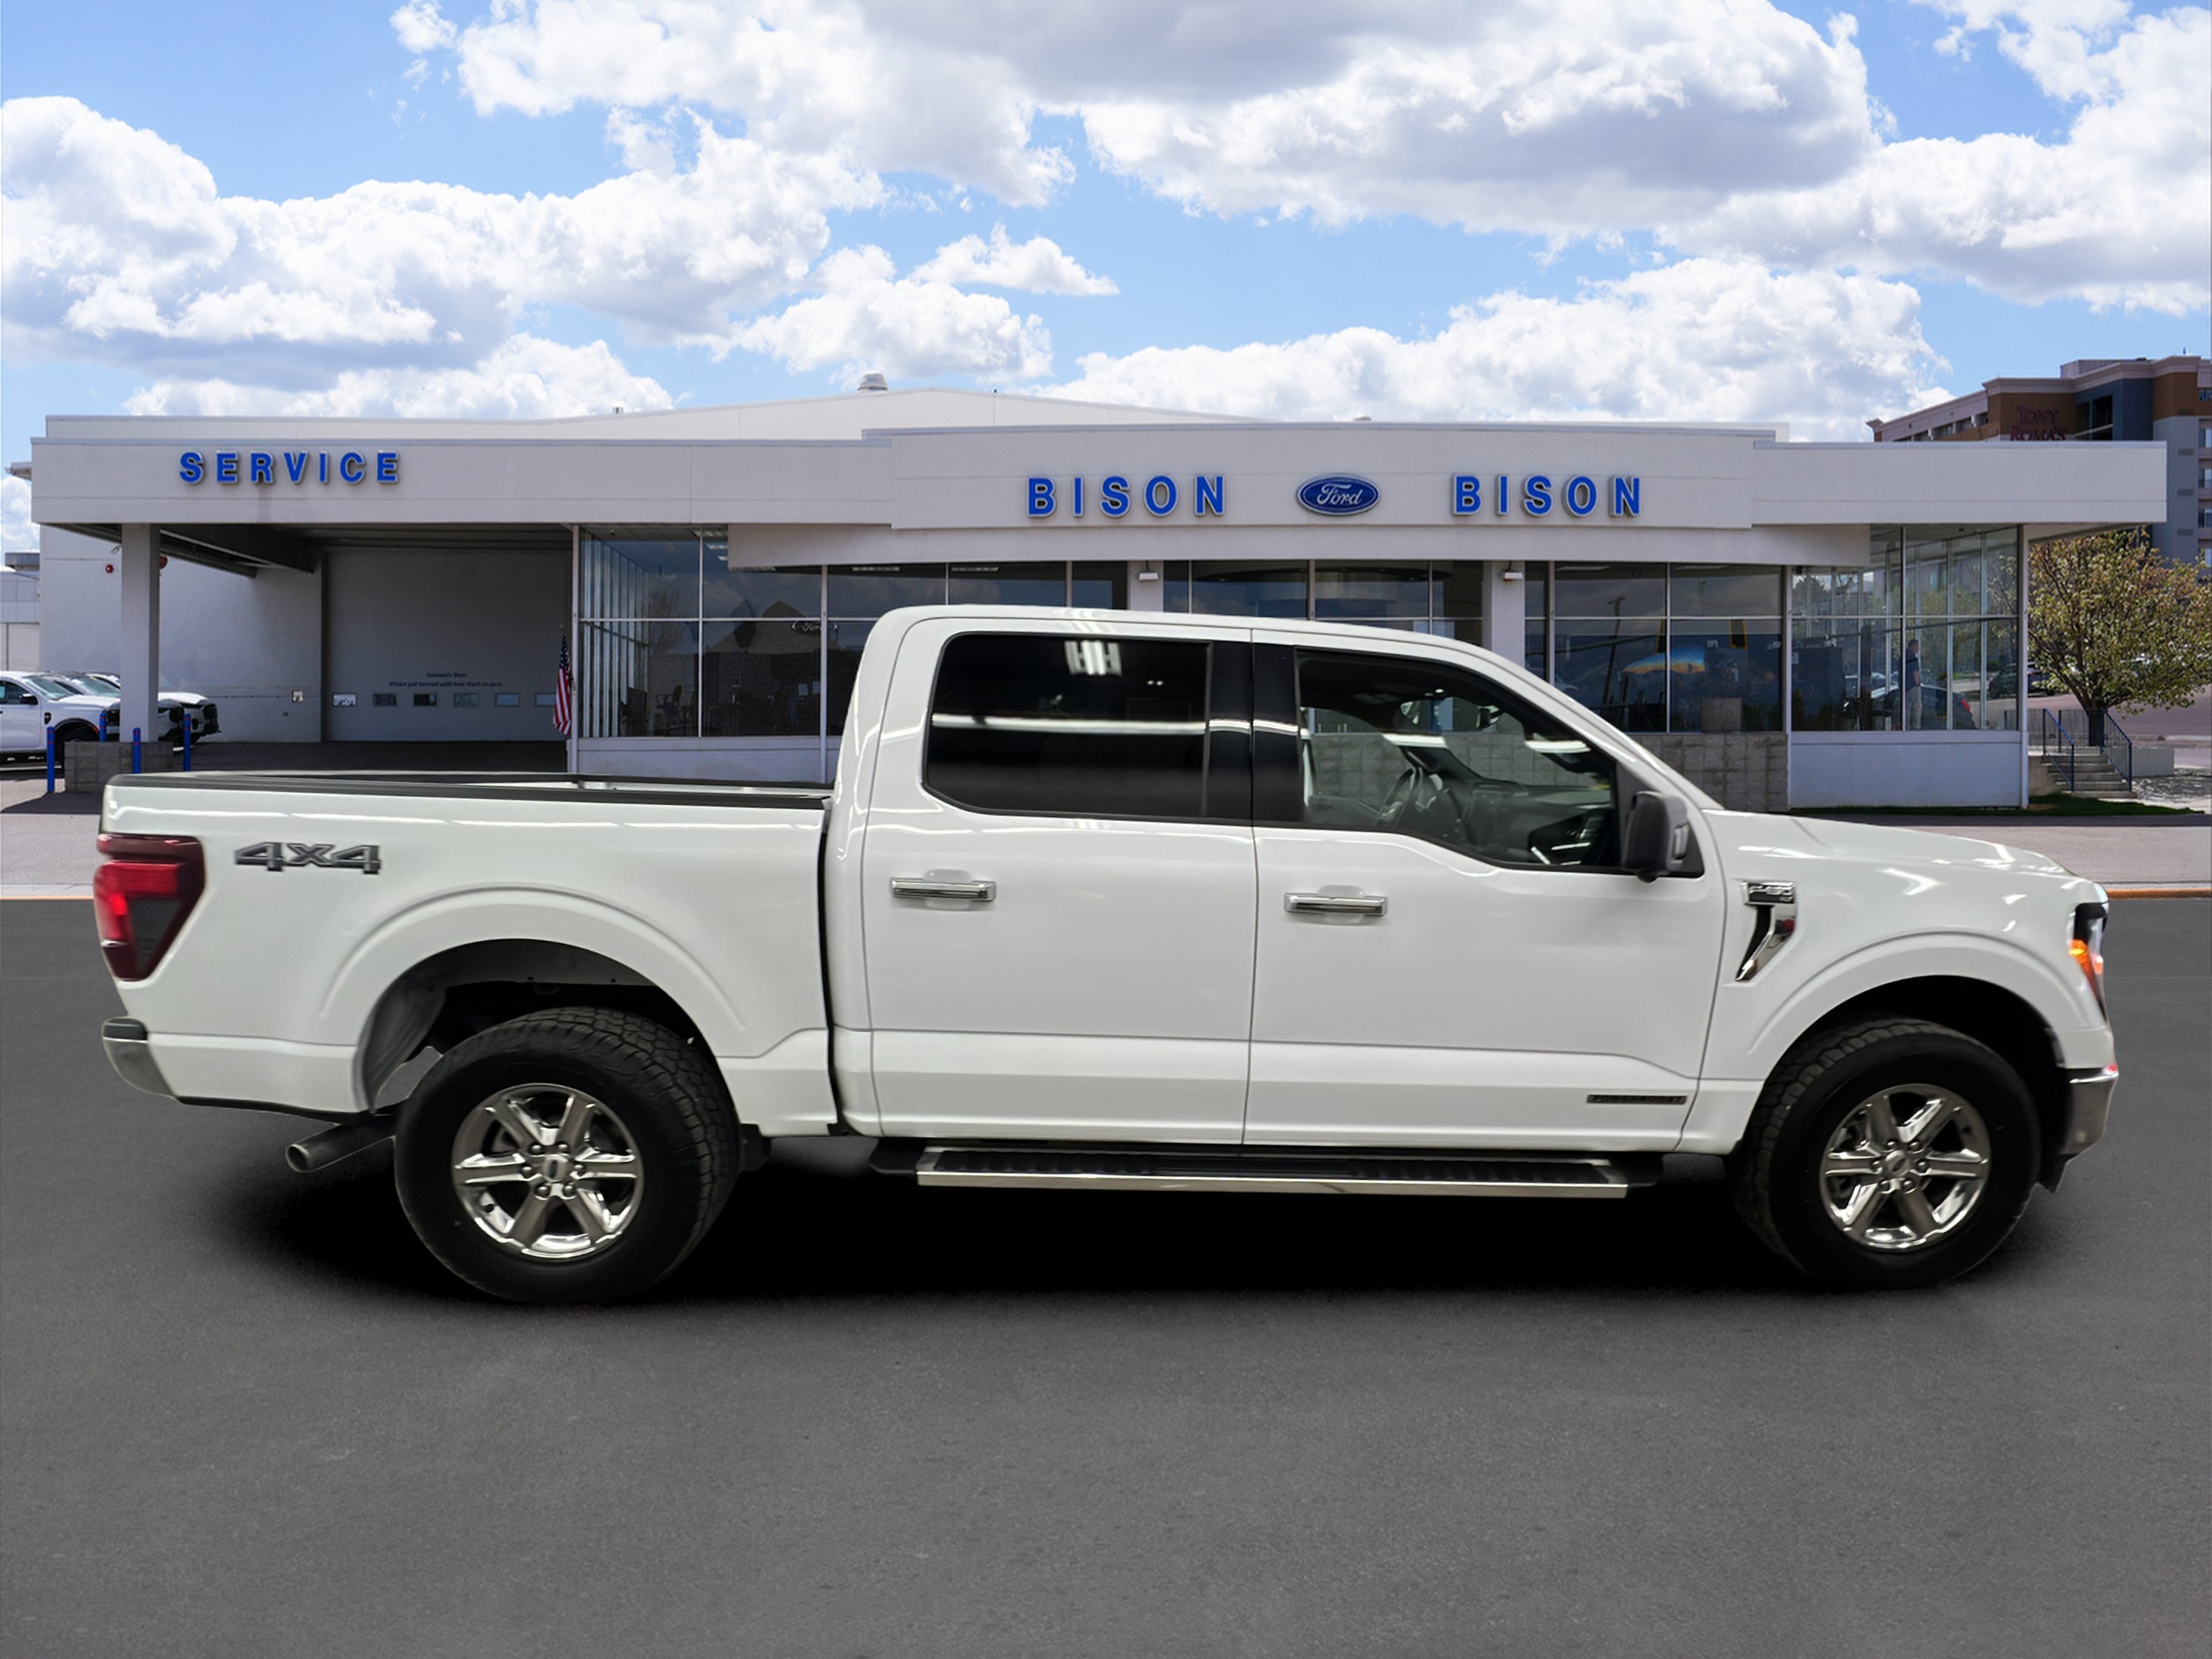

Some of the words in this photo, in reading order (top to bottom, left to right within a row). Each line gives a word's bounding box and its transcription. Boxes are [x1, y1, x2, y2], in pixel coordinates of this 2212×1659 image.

[2017, 406, 2059, 423] TONY
[179, 451, 400, 484] SERVICE
[1028, 475, 1224, 518] BISON
[1316, 484, 1363, 505] Ford
[1454, 475, 1642, 517] BISON
